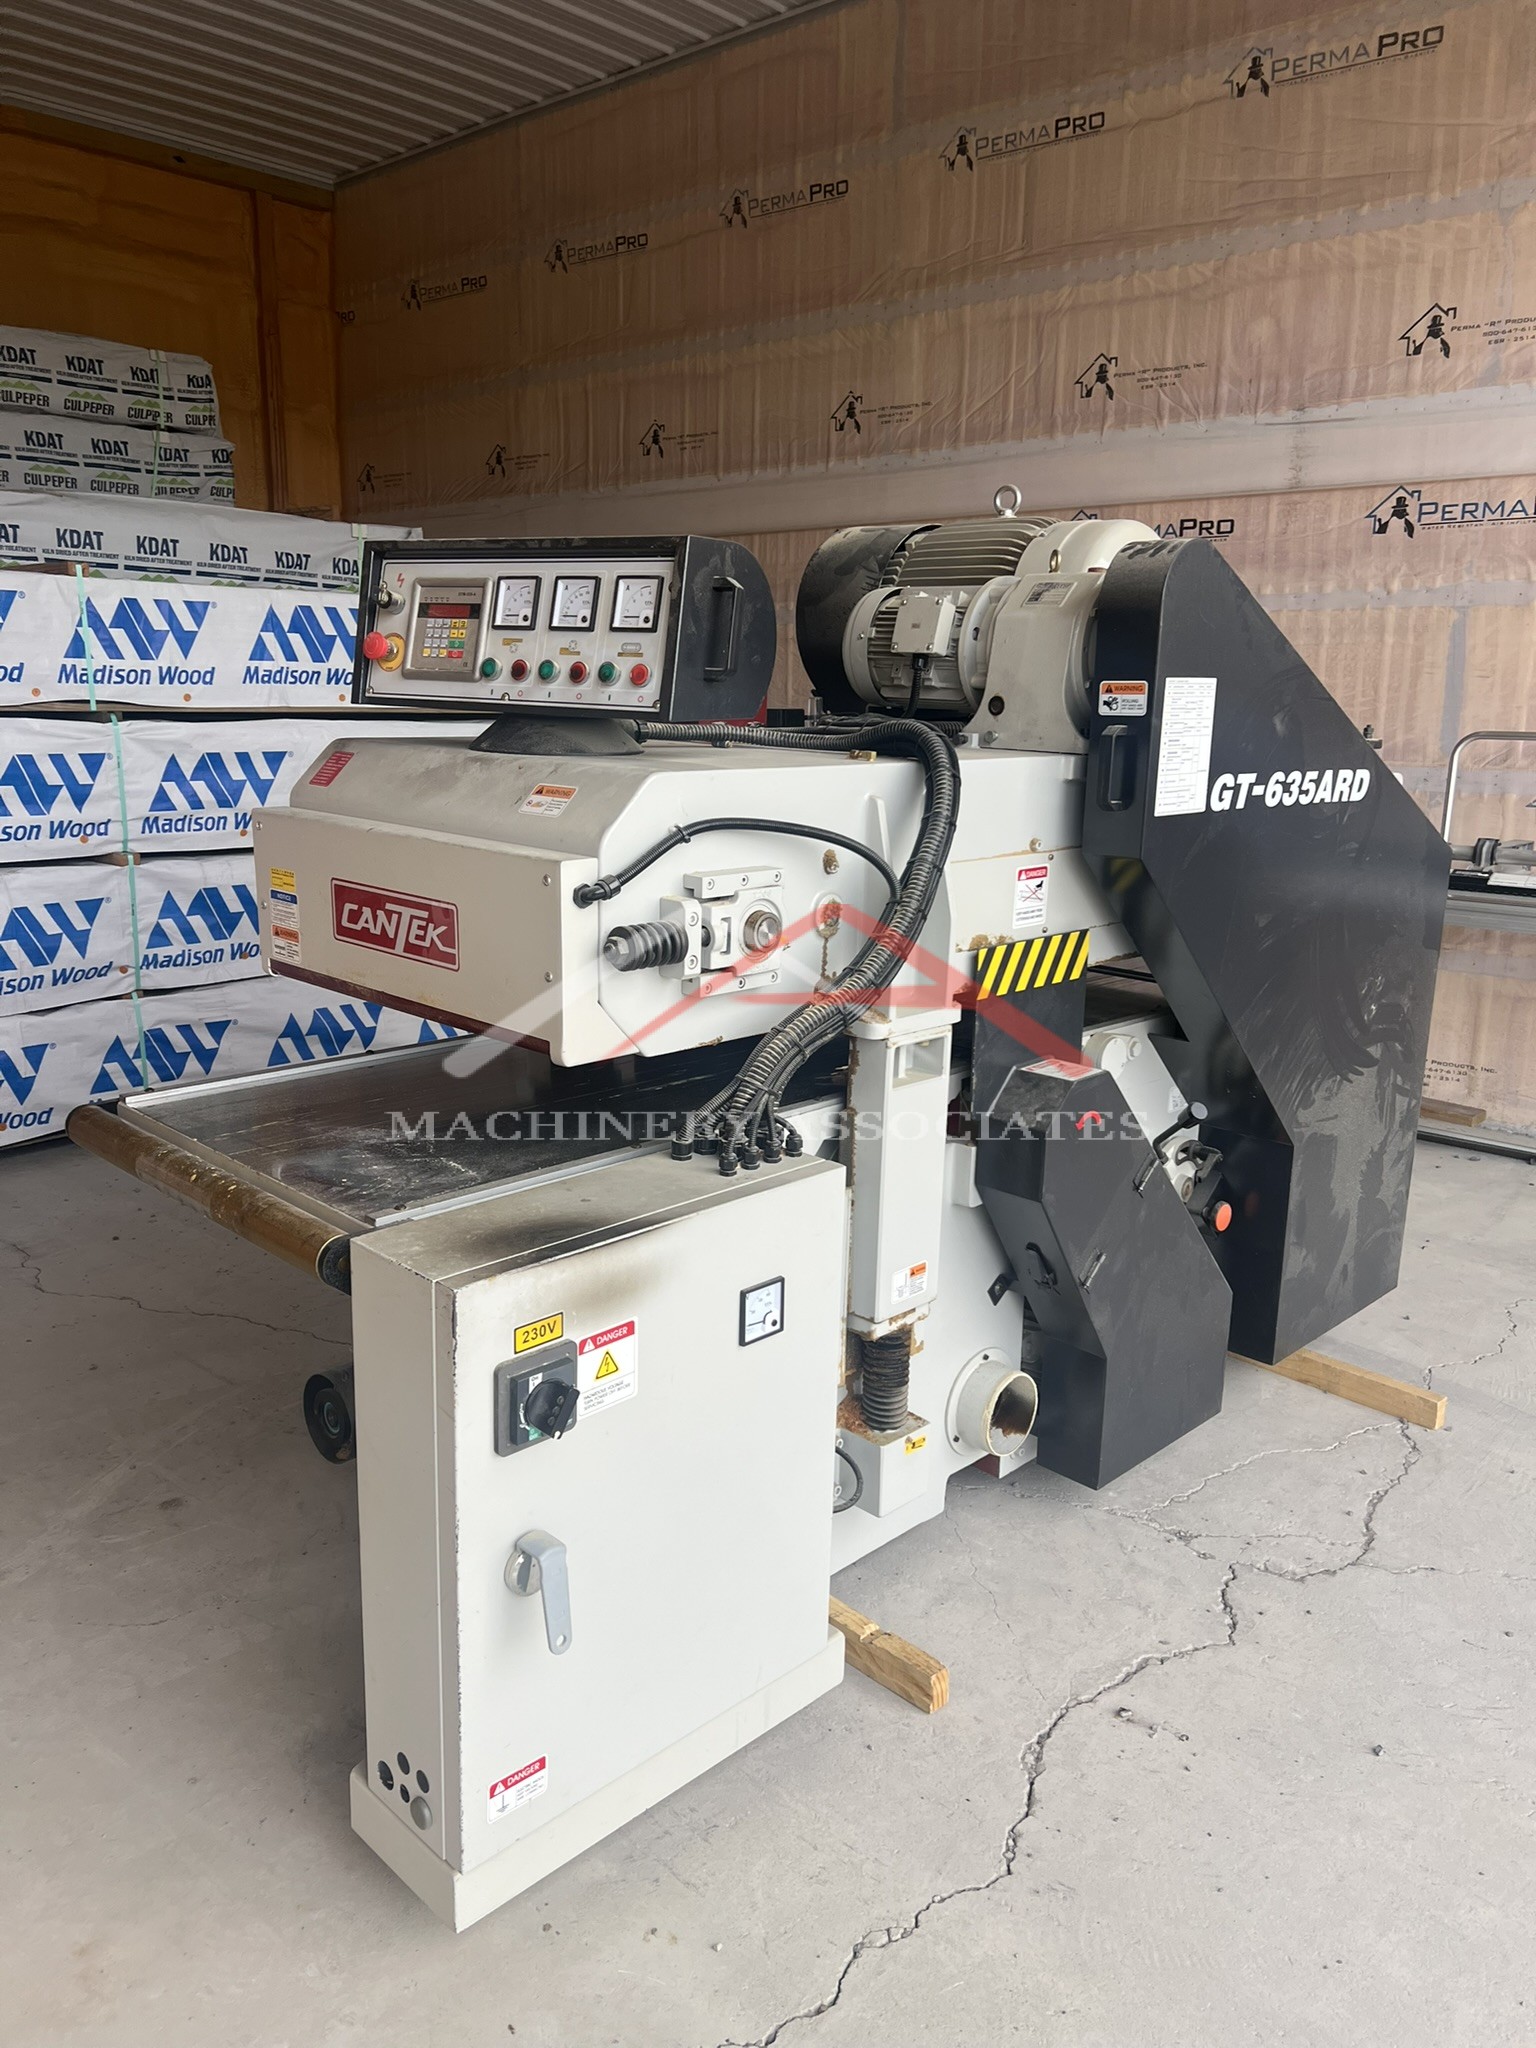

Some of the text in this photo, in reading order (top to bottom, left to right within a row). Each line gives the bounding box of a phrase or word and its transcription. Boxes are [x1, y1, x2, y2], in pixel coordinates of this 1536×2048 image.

[1505, 316, 1536, 326] PRODU
[65, 355, 104, 375] KDAT
[187, 374, 212, 388] KDA
[64, 398, 115, 416] CULPEPER
[24, 430, 64, 450] KDAT
[91, 438, 129, 457] KDAT
[24, 472, 78, 490] CULPEPER
[90, 479, 139, 496] CULPEPER
[56, 527, 104, 551] KDAT
[136, 535, 180, 558] KDAT
[209, 543, 248, 565] KDAT
[275, 551, 311, 571] KDAT
[333, 557, 359, 577] KDA
[0, 662, 25, 684] od
[57, 663, 215, 686] Madison Wood
[242, 666, 353, 686] Madison Wo
[1114, 684, 1143, 693] WARNING
[1210, 768, 1371, 813] GT-635ARD
[49, 818, 112, 840] Wood
[141, 814, 228, 835] Madison
[341, 902, 457, 955] CANTEK
[140, 946, 224, 971] Madison
[230, 942, 261, 961] Wo
[51, 960, 114, 987] Wood
[522, 1320, 557, 1345] 230V
[596, 1326, 629, 1346] DANGER
[507, 1762, 541, 1786] DANGER
